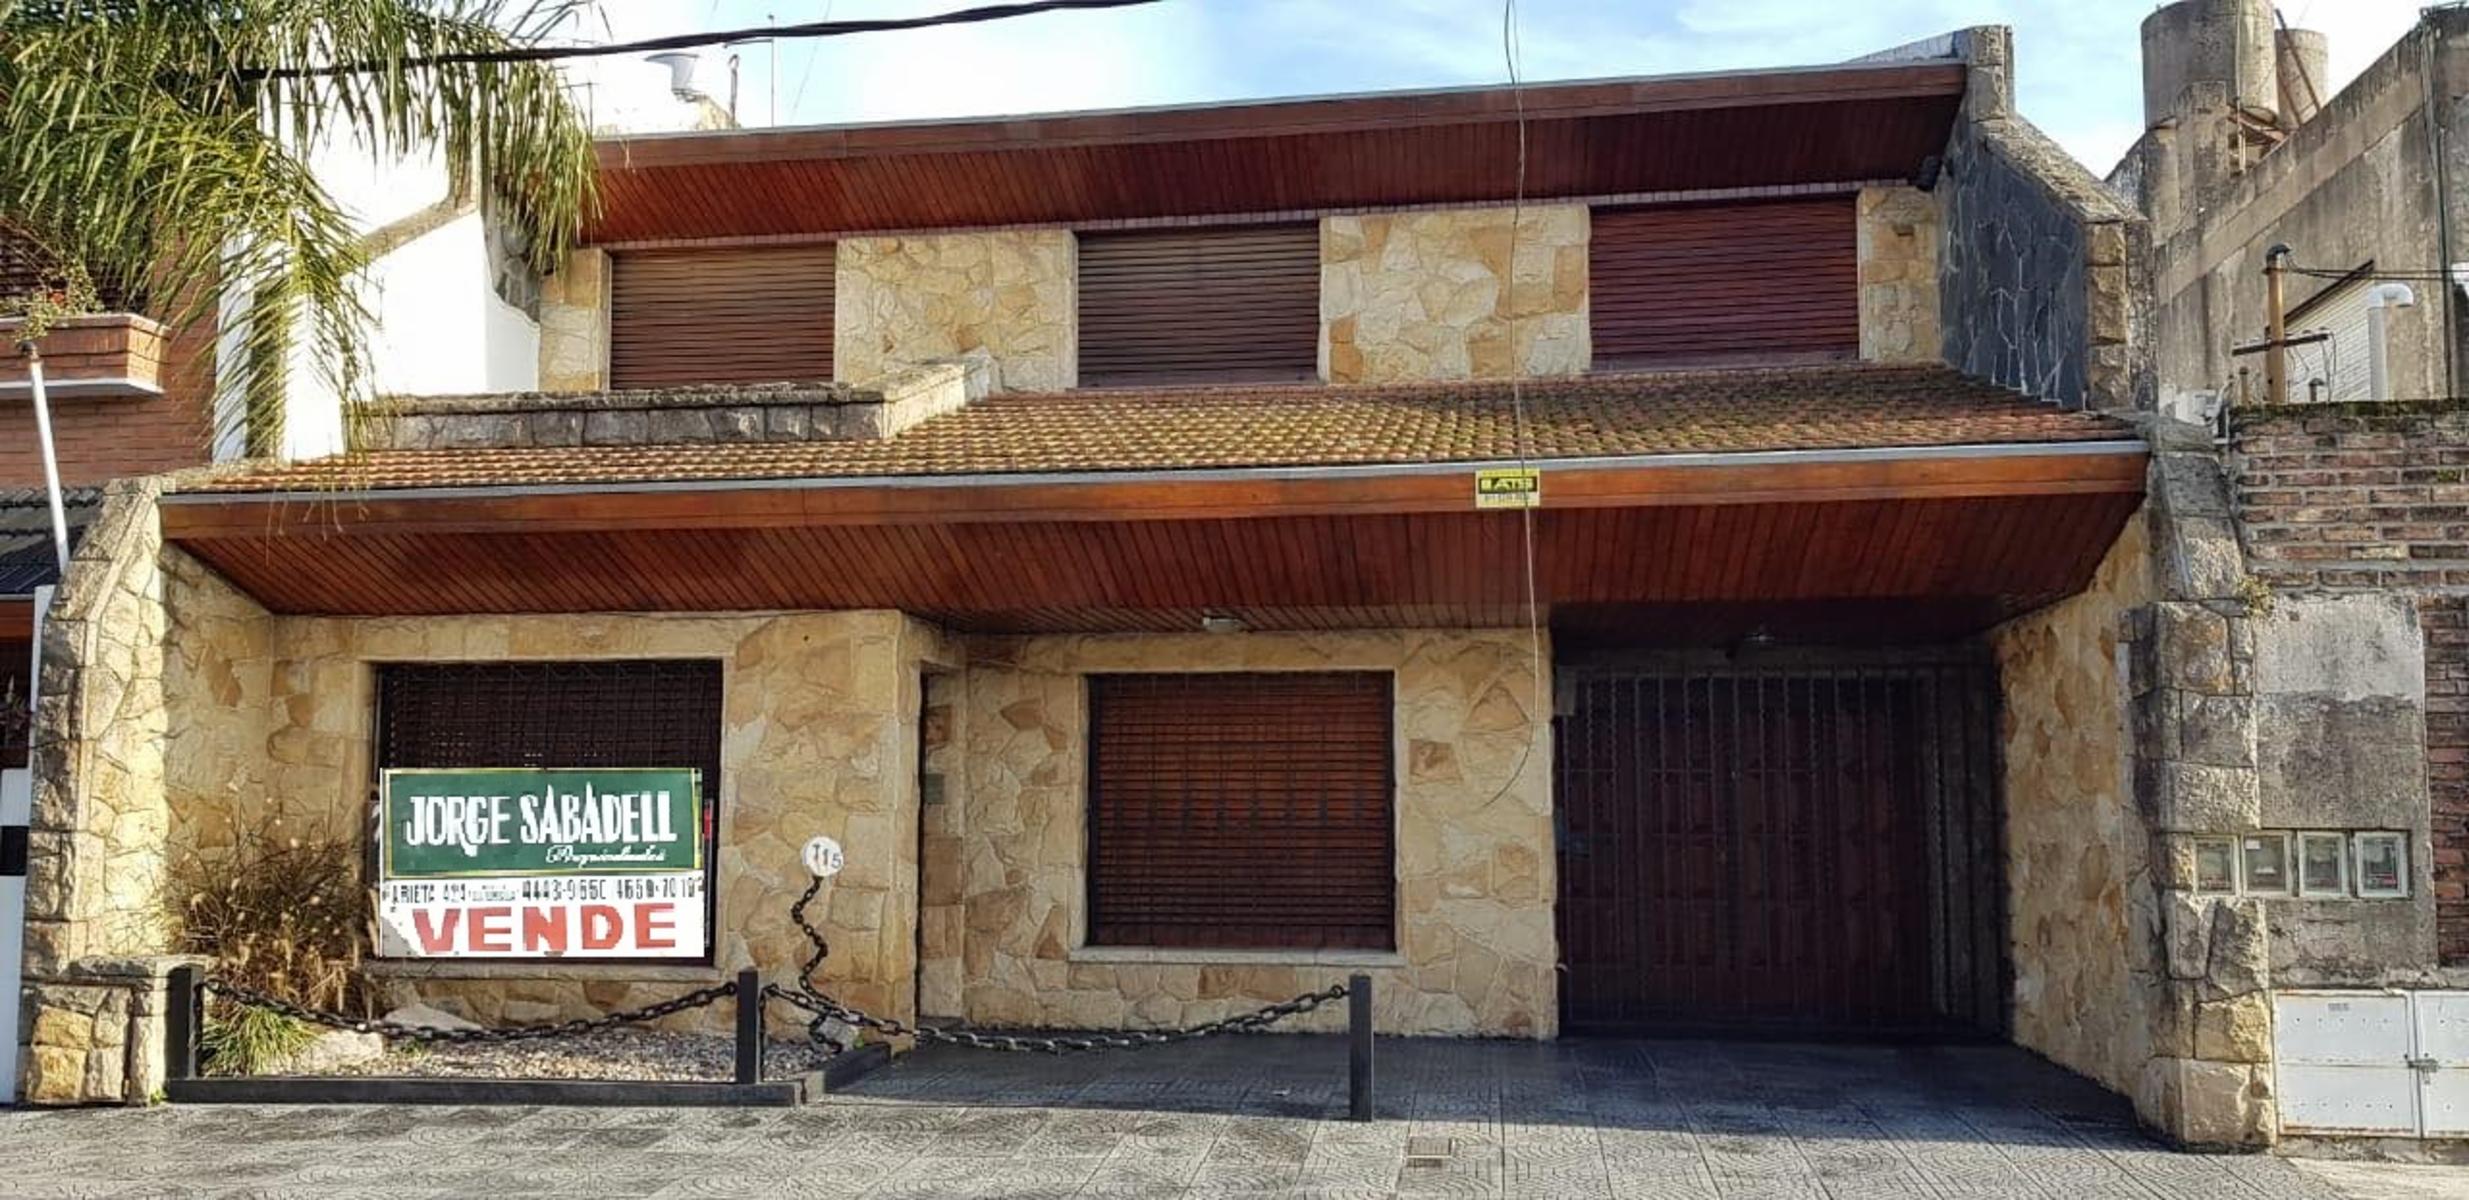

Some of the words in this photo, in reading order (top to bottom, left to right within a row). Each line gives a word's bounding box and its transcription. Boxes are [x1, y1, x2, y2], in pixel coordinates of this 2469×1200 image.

[406, 796, 512, 857] JORGE
[519, 781, 678, 844] SABADELL
[411, 902, 676, 955] VENDE
